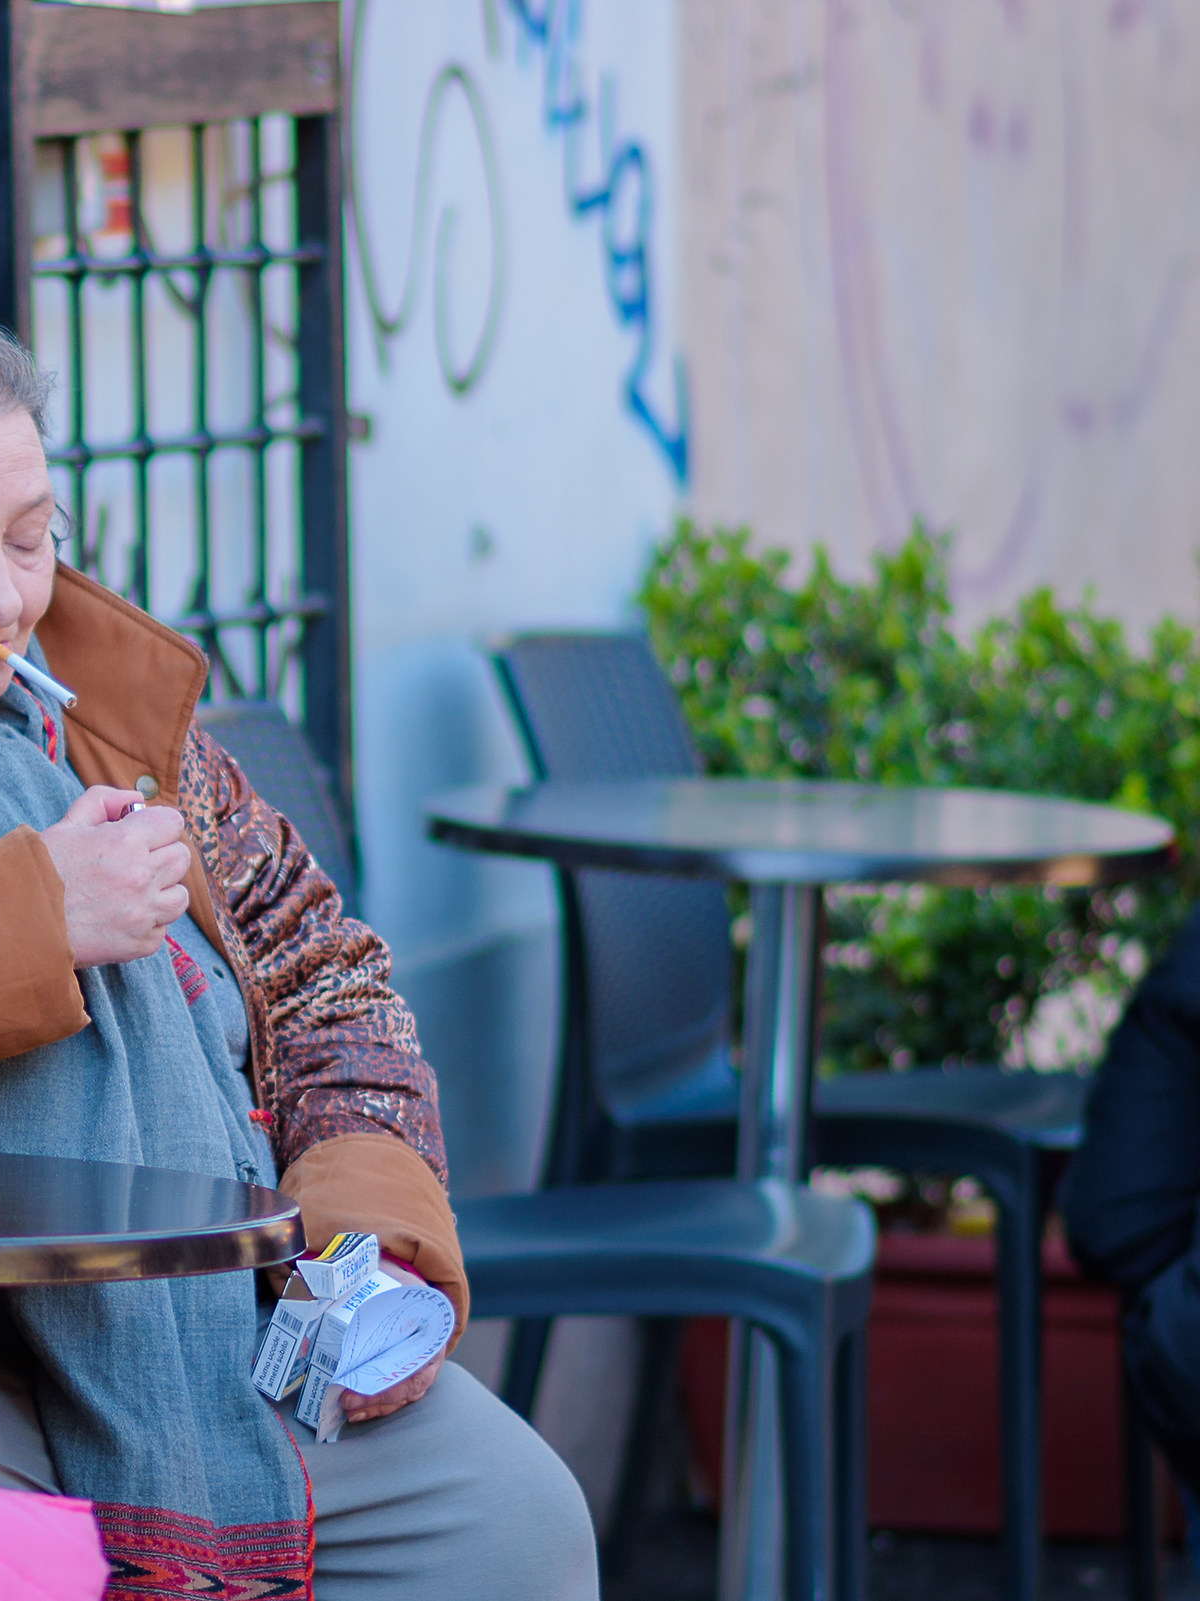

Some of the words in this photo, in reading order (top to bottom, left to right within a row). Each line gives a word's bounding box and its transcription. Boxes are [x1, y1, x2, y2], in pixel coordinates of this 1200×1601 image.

[342, 1279, 380, 1312] YESMOKE
[259, 1361, 271, 1381] fumo
[269, 1335, 280, 1360] uccide
[267, 1363, 280, 1388] smetti
[277, 1340, 289, 1362] subito
[305, 1399, 314, 1416] fumo
[311, 1376, 321, 1398] uccide
